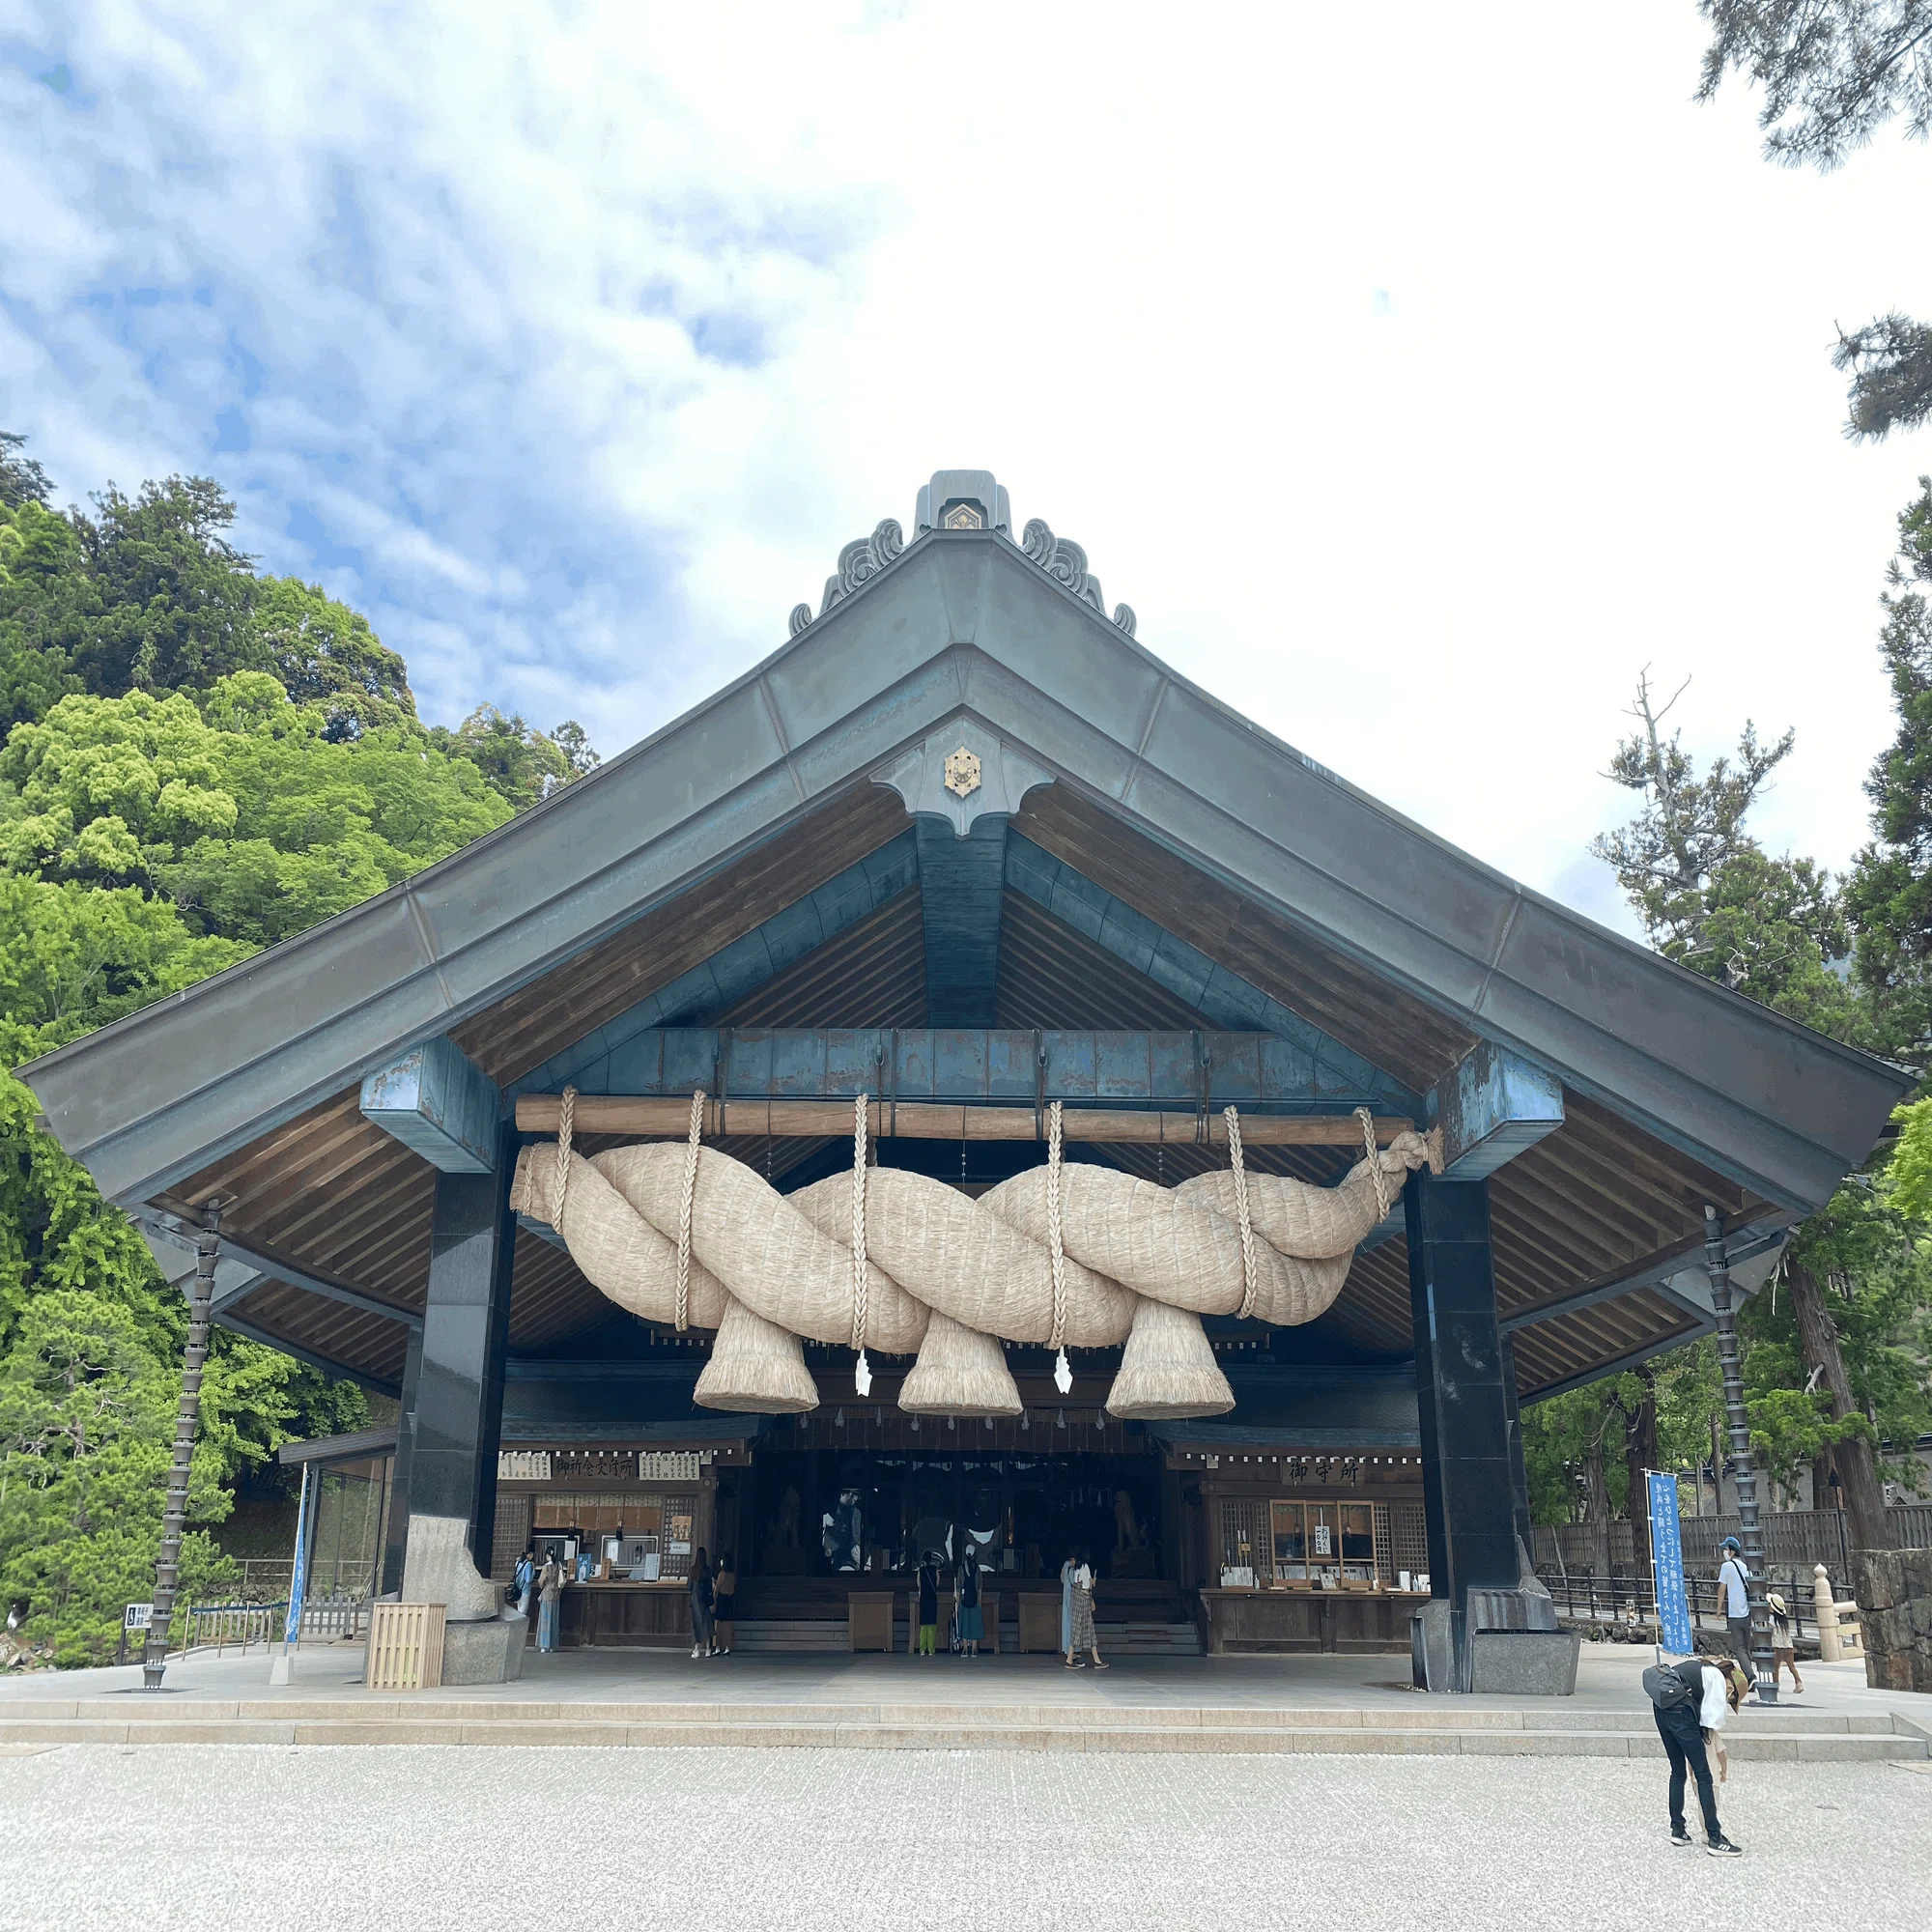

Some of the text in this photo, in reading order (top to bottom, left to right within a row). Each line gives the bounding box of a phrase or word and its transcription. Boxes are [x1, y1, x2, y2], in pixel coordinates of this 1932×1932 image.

[556, 1458, 633, 1477] 御祈念受付所
[1289, 1462, 1359, 1484] 御守所
